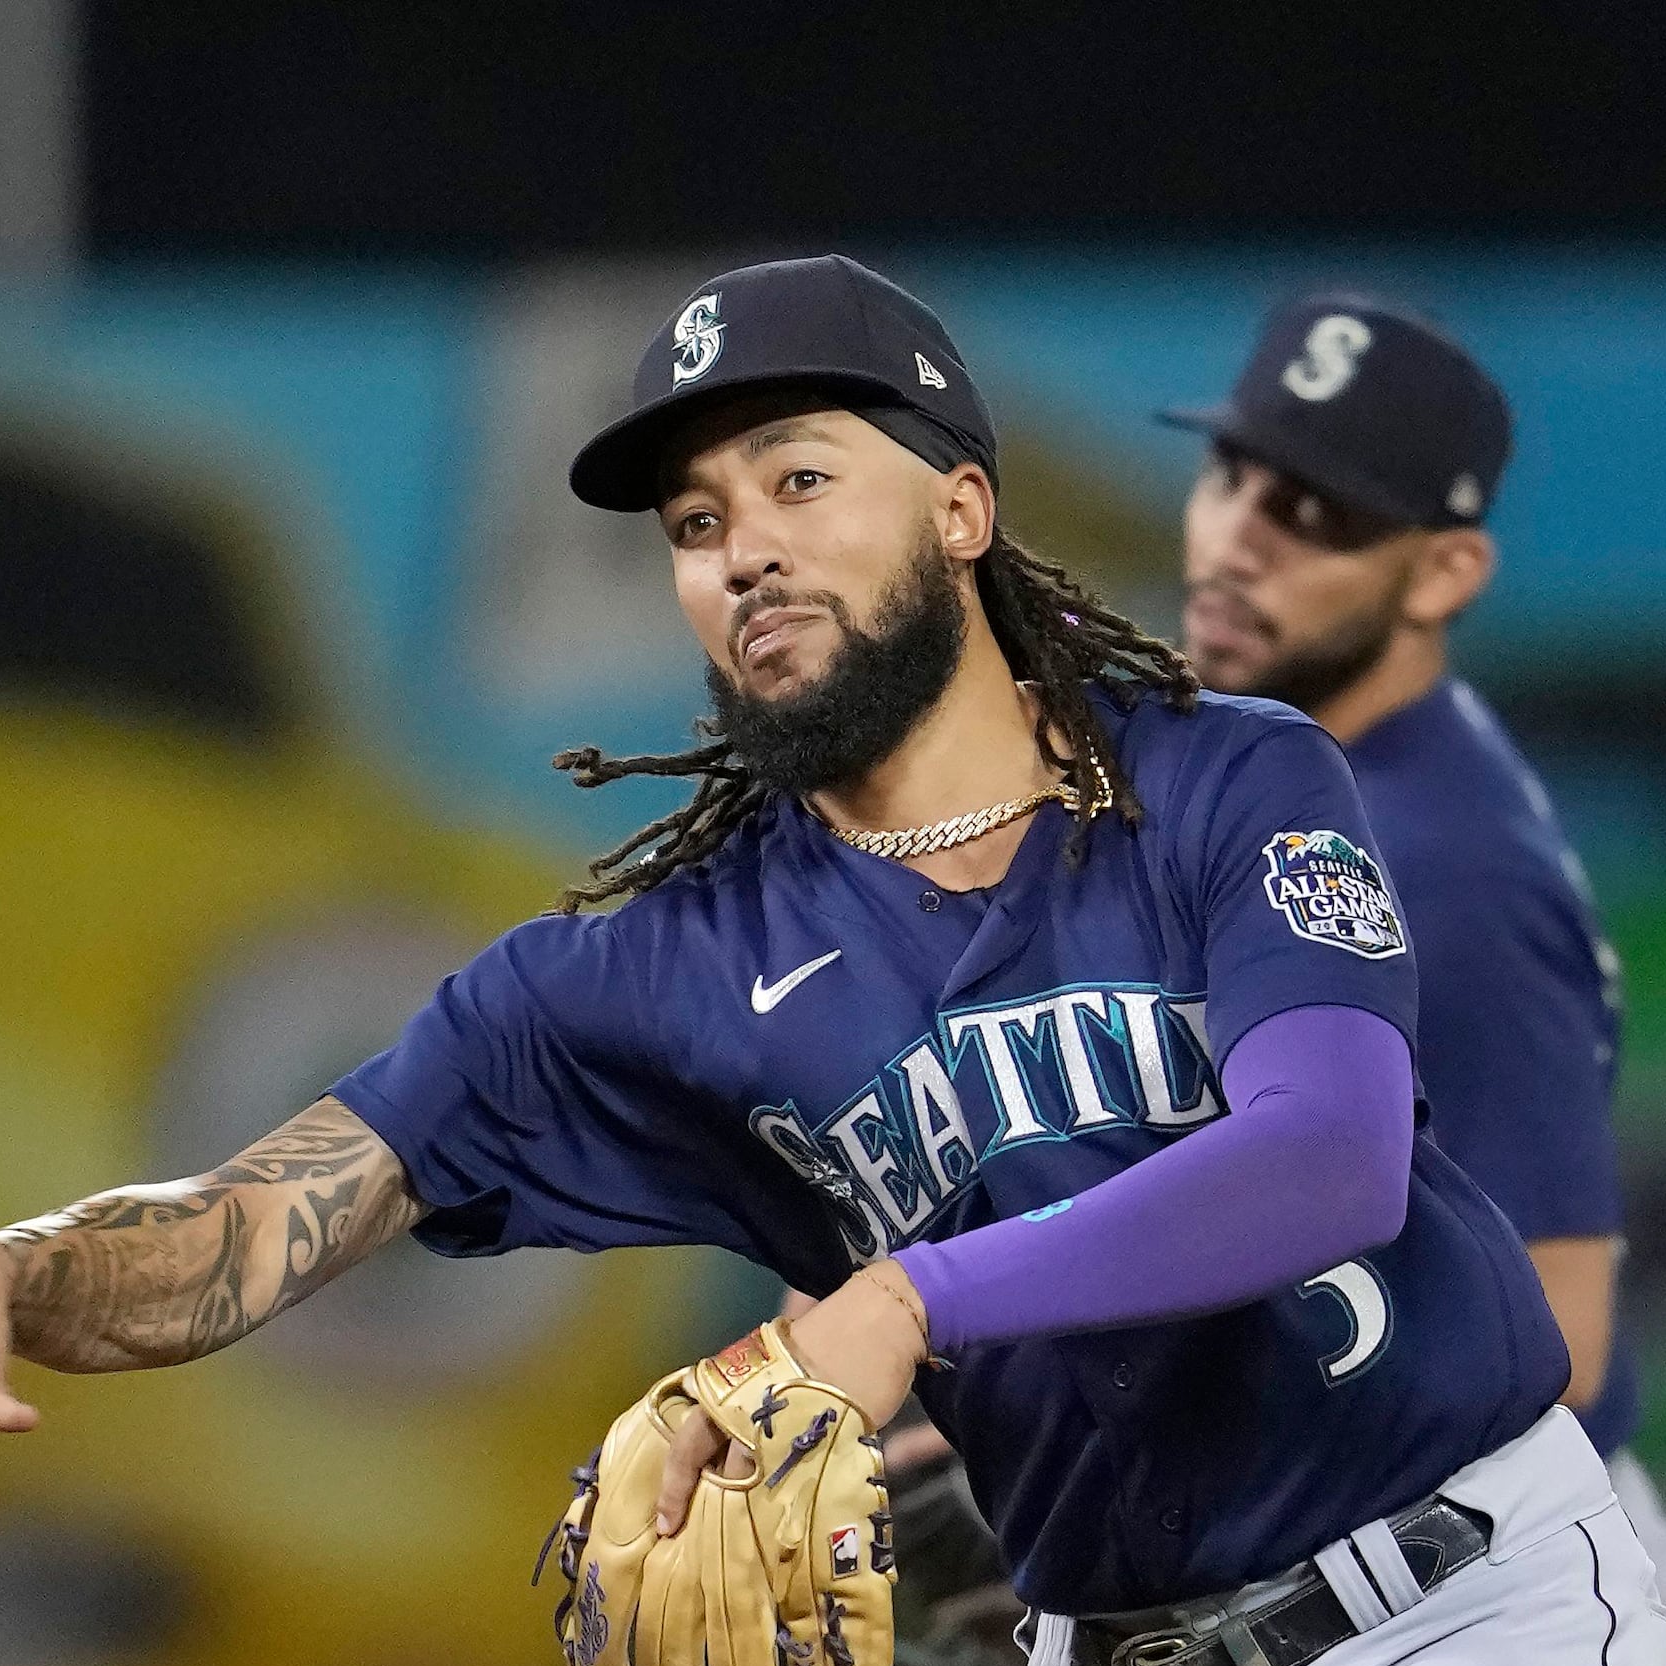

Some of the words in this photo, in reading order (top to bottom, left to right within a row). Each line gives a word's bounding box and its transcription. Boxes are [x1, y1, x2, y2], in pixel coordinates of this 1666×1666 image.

[672, 291, 728, 392] S
[1282, 314, 1371, 401] S
[1308, 859, 1365, 880] SEATTLE
[1308, 895, 1388, 928] GAME
[747, 981, 1232, 1268] SEATTL
